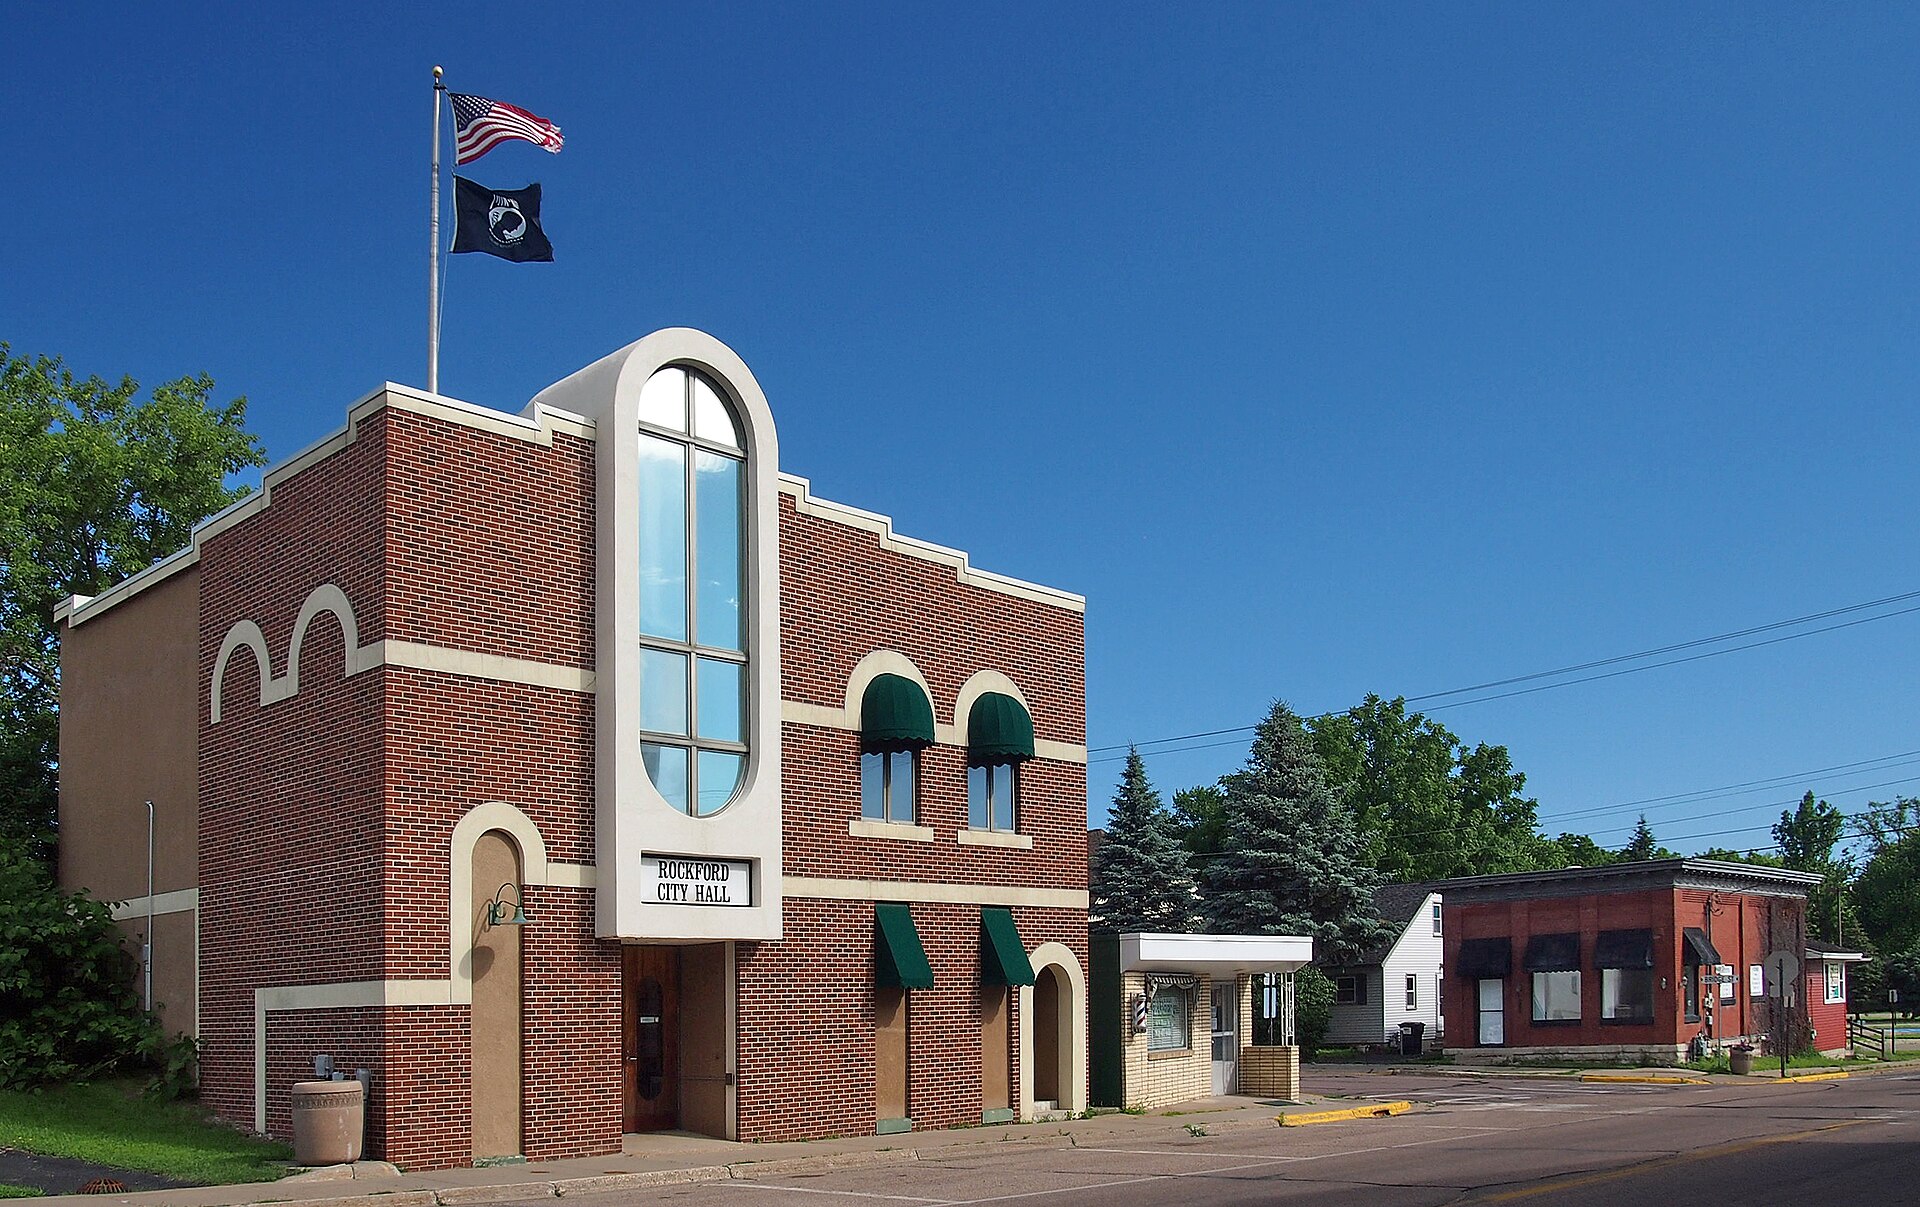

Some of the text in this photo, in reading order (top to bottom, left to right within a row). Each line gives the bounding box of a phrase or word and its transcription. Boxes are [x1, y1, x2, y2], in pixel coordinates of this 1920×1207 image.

[658, 860, 729, 881] ROCKFORD
[657, 883, 731, 903] CITY HALL
